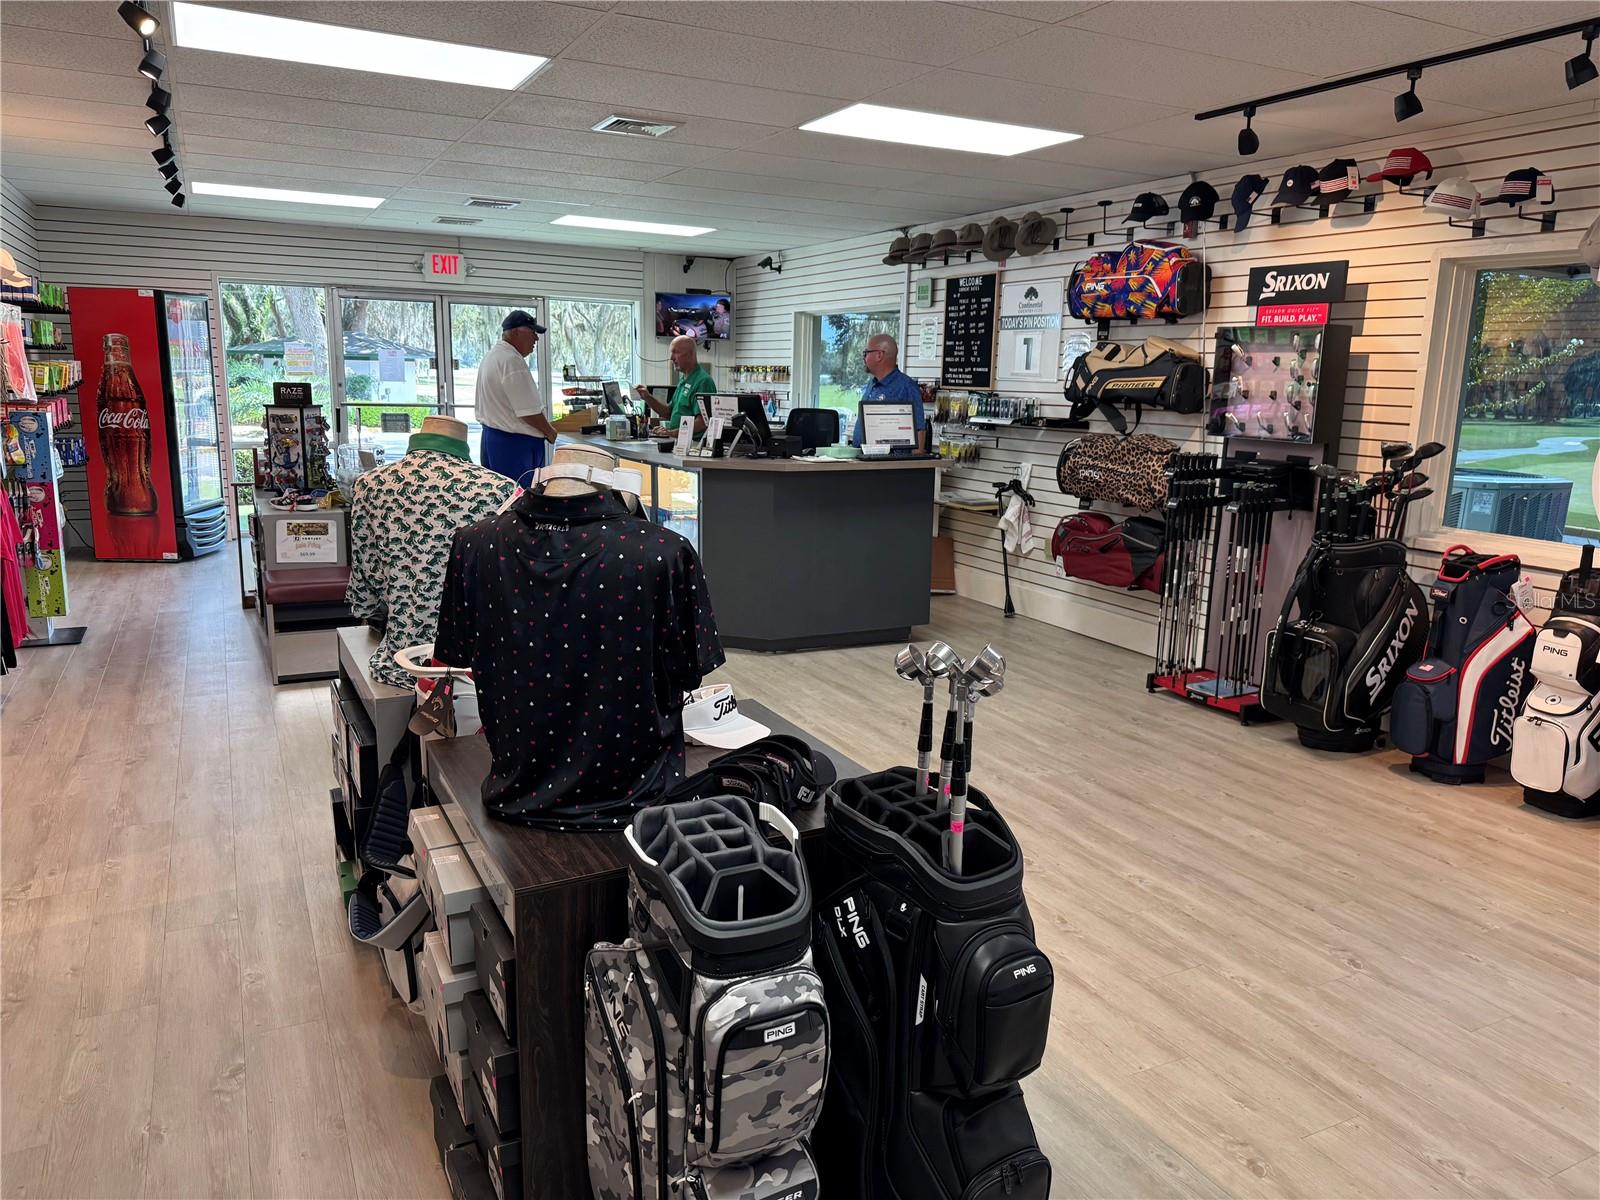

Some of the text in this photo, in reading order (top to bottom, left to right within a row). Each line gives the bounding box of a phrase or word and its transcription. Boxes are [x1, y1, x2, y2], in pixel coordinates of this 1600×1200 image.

[432, 254, 459, 275] EXIT
[959, 276, 983, 287] WELCOME
[1085, 282, 1105, 291] PING
[1259, 271, 1330, 300] SRIXON
[1002, 314, 1060, 329] TODAY'S PIN POSITION
[1261, 315, 1273, 323] FIT.
[1274, 314, 1297, 323] BUILD.
[1023, 337, 1033, 370] 1
[280, 387, 303, 395] RAZE
[1365, 598, 1419, 707] SRIXON
[1542, 645, 1568, 657] PING
[1490, 657, 1526, 752] Titleist
[843, 896, 871, 949] PING
[1013, 963, 1037, 979] PING
[766, 1025, 793, 1040] PING
